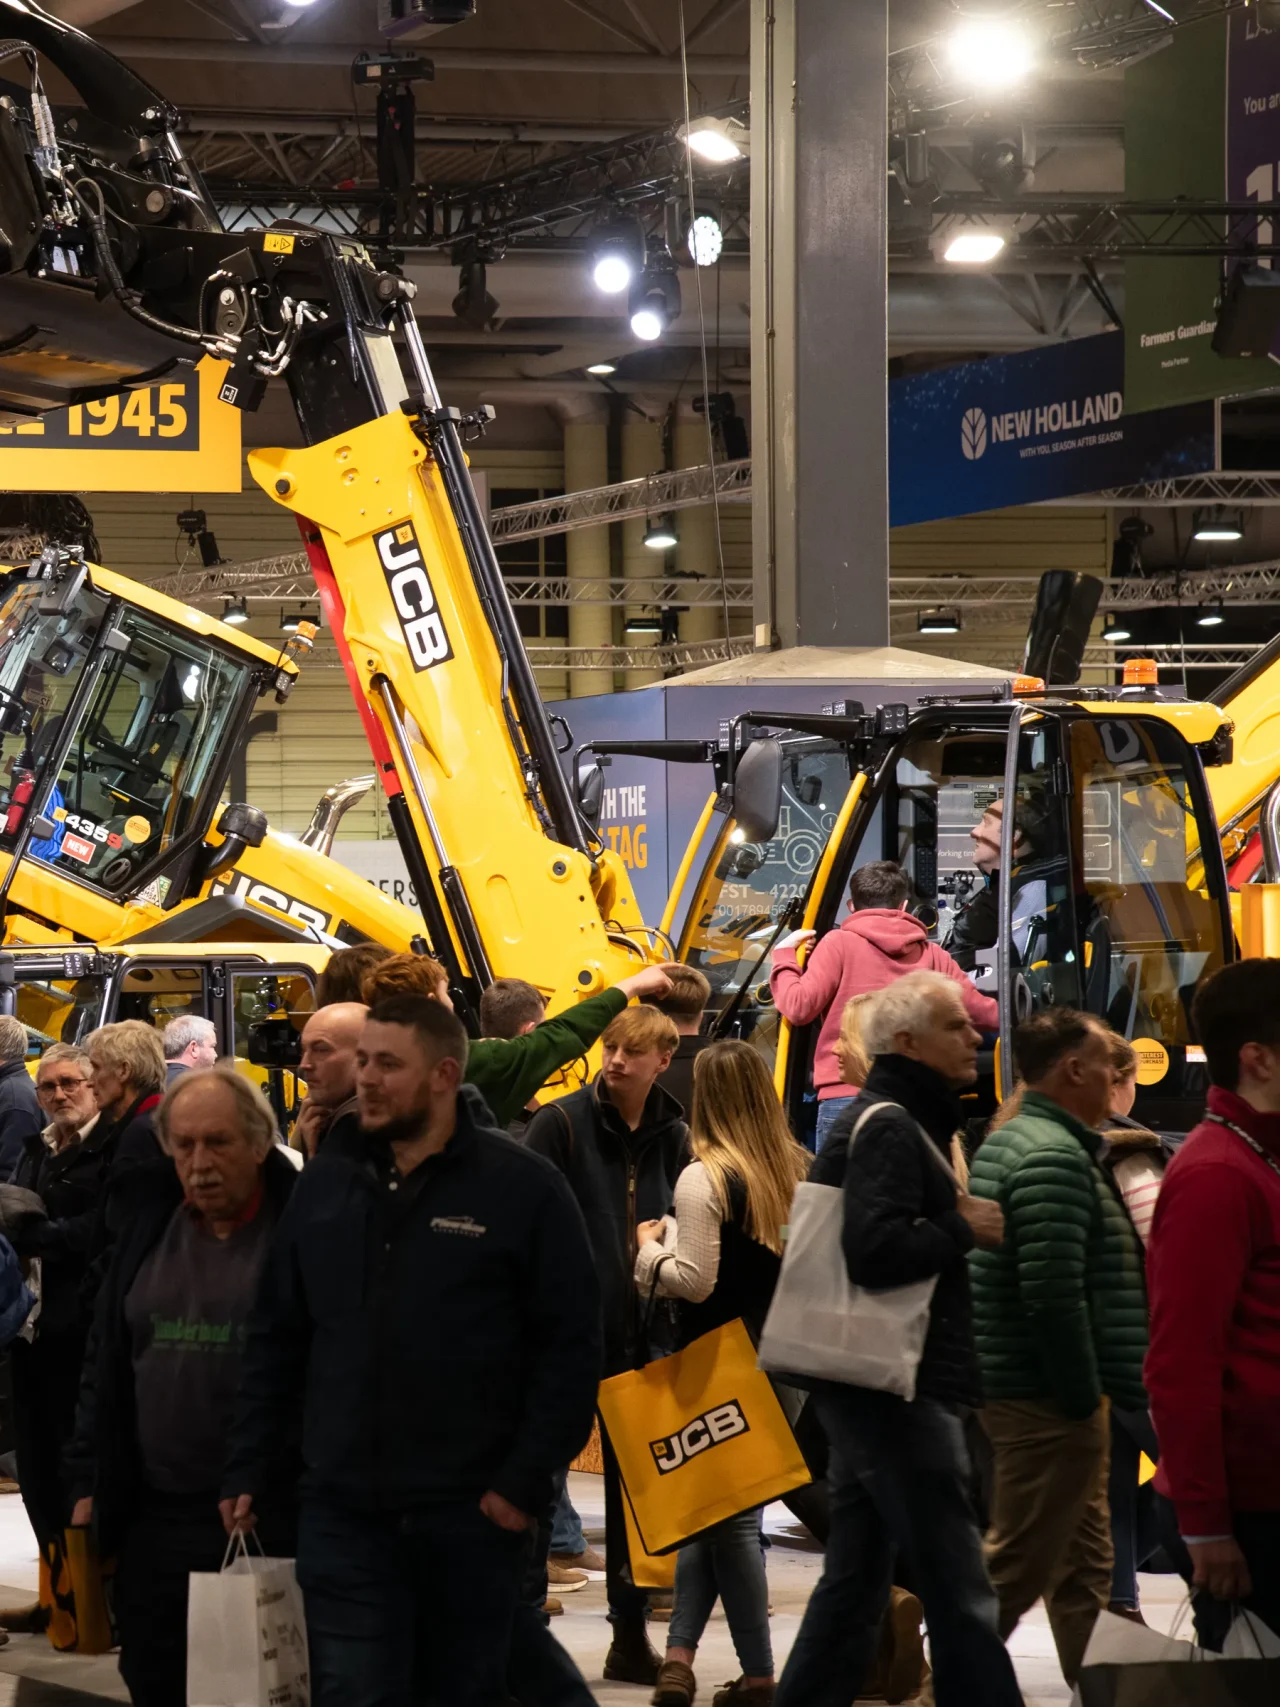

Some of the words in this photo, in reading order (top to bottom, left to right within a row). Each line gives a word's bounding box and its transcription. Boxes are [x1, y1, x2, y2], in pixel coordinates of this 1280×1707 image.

[1244, 96, 1266, 115] You
[1140, 330, 1176, 348] Farmers
[68, 383, 188, 438] 1945
[991, 409, 1032, 444] NEW
[1035, 391, 1123, 435] HOLLAND
[1019, 447, 1036, 459] WITH
[1051, 440, 1076, 453] SEASON
[1077, 436, 1097, 447] AFTER
[1097, 431, 1123, 445] SEASON
[378, 531, 449, 667] JCB
[619, 785, 647, 818] THE
[65, 815, 124, 849] 435S
[67, 839, 90, 857] NEW
[607, 823, 648, 869] TAG
[963, 850, 976, 858] tim
[213, 876, 326, 935] JCB
[657, 1404, 746, 1471] JCB
